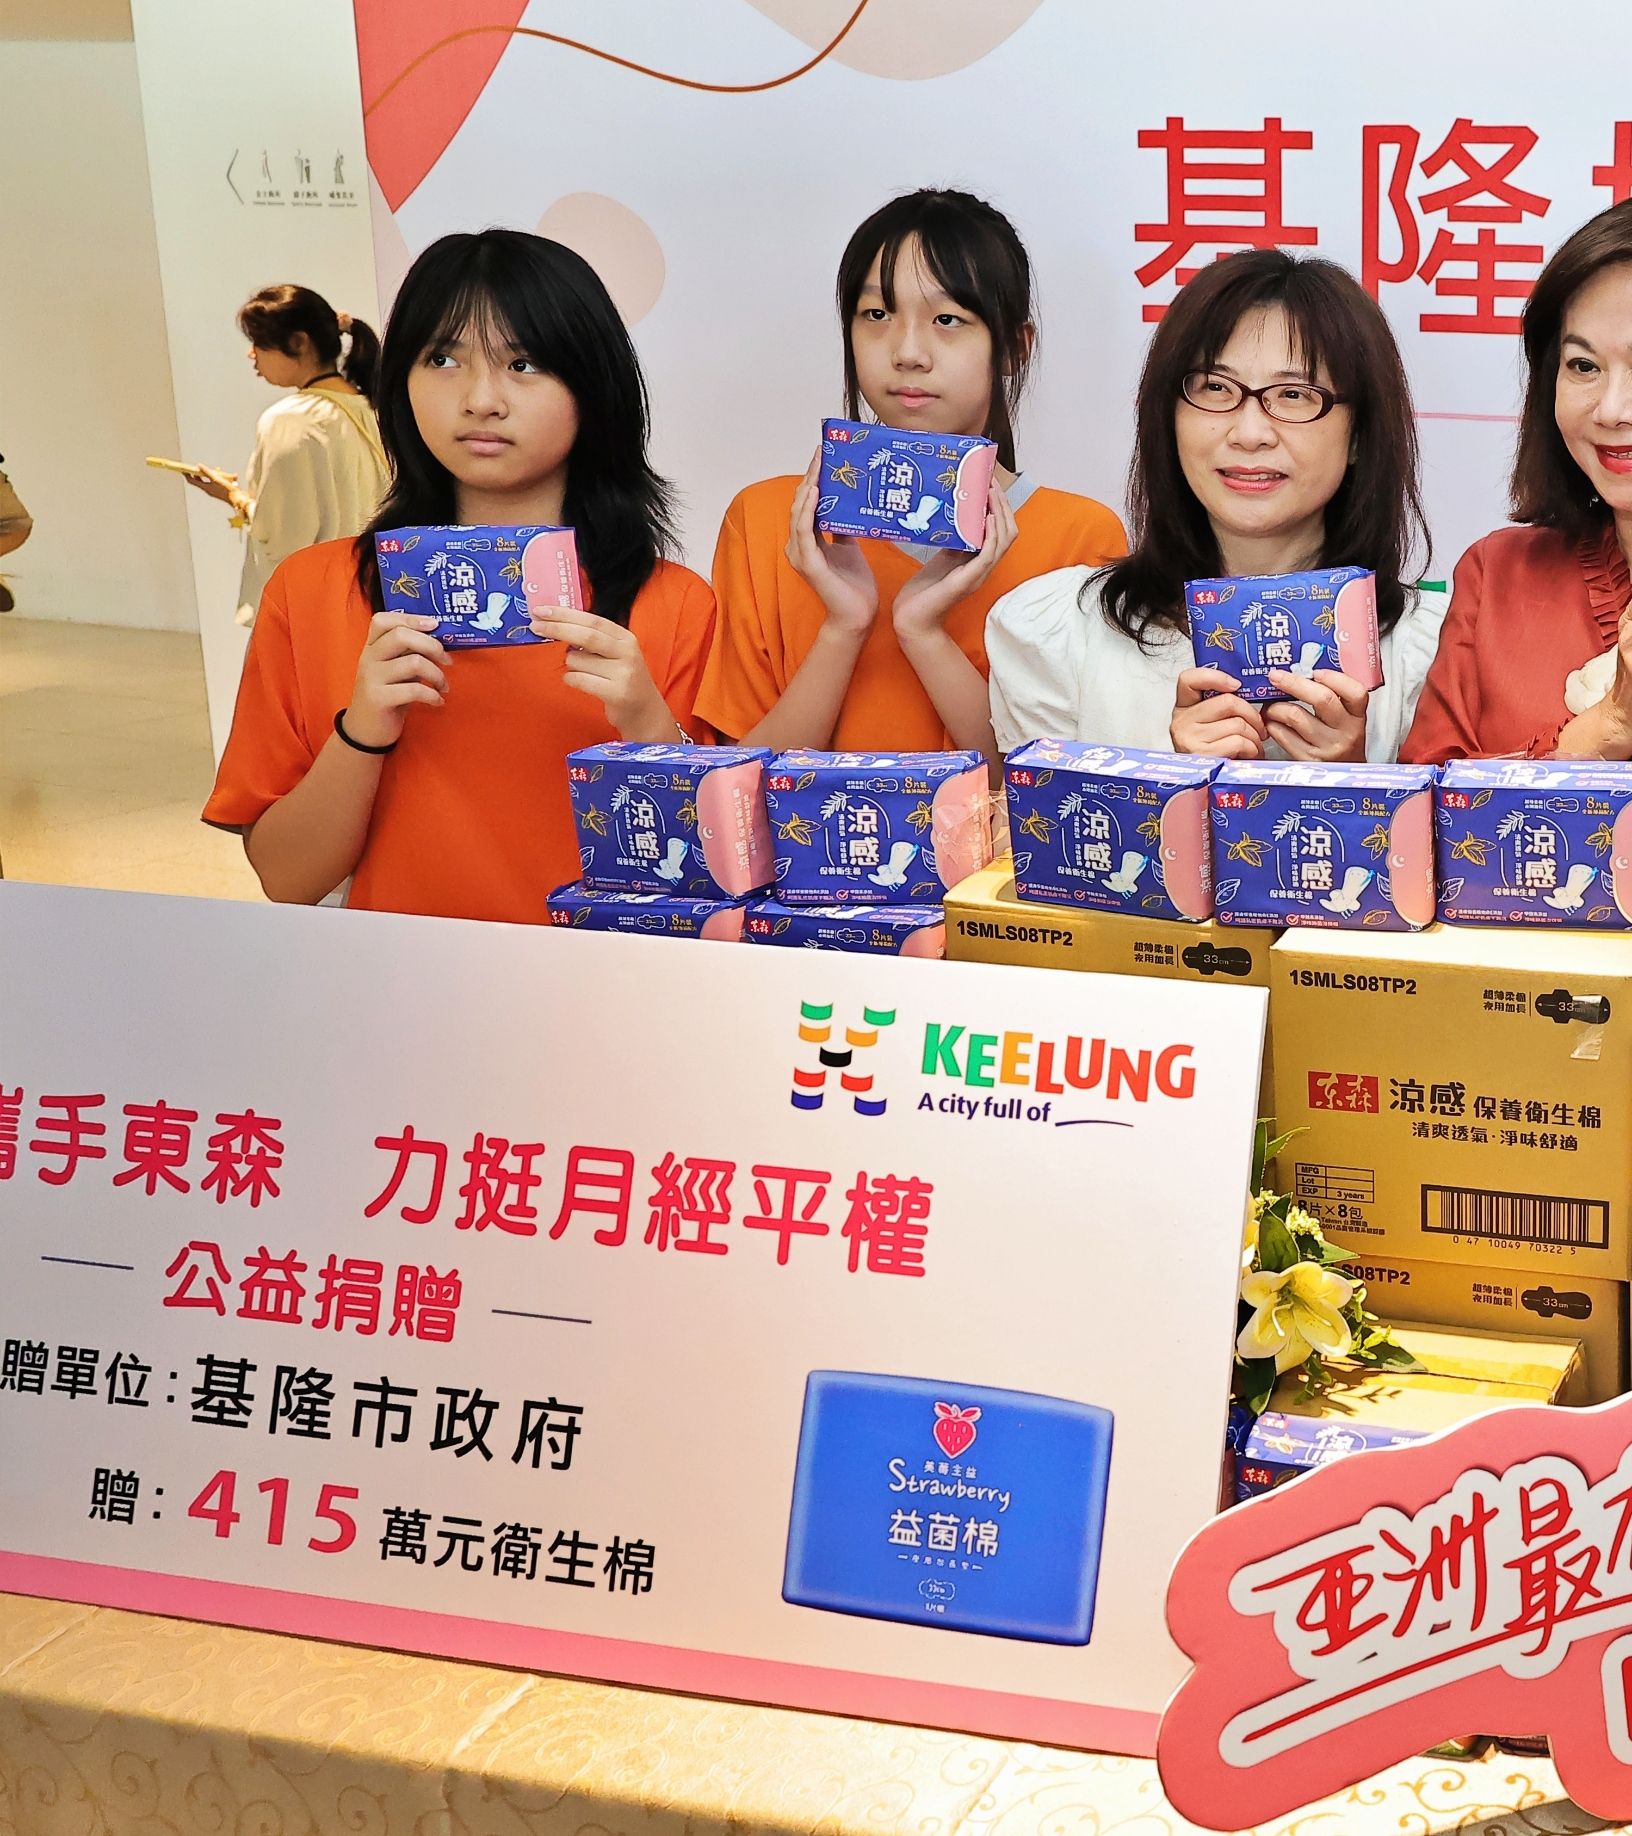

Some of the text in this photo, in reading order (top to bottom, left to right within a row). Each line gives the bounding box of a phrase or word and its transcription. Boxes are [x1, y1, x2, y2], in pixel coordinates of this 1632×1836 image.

[885, 461, 914, 513] 涼感
[447, 562, 478, 614] 涼感
[1262, 611, 1292, 665] 涼感
[630, 799, 660, 859] 涼感
[847, 804, 880, 866] 涼感
[1082, 808, 1112, 872] 涼感
[1524, 824, 1557, 888] 涼感
[1300, 826, 1333, 891] 涼感
[956, 920, 1074, 947] 1SMLS08TP2
[1203, 953, 1230, 967] 33cm
[1289, 970, 1417, 996] 1SMLS08TP2
[921, 1022, 1196, 1102] KEELUNG
[917, 1092, 1051, 1122] A city full of
[1389, 1078, 1467, 1117] 涼感
[1473, 1096, 1602, 1129] 保養衛生棉
[364, 1124, 935, 1278] 力挺月經平權
[1301, 1177, 1315, 1185] Lot
[1467, 1237, 1480, 1246] 47
[1488, 1239, 1521, 1251] 10049
[1529, 1243, 1563, 1255] 70322
[162, 1241, 463, 1344] 公益捐贈
[190, 1354, 585, 1472] 基隆市政府
[888, 1457, 1012, 1513] Strawberry
[187, 1469, 361, 1554] 415
[378, 1506, 656, 1597] 萬元衛生棉
[888, 1508, 999, 1558] 益菌棉
